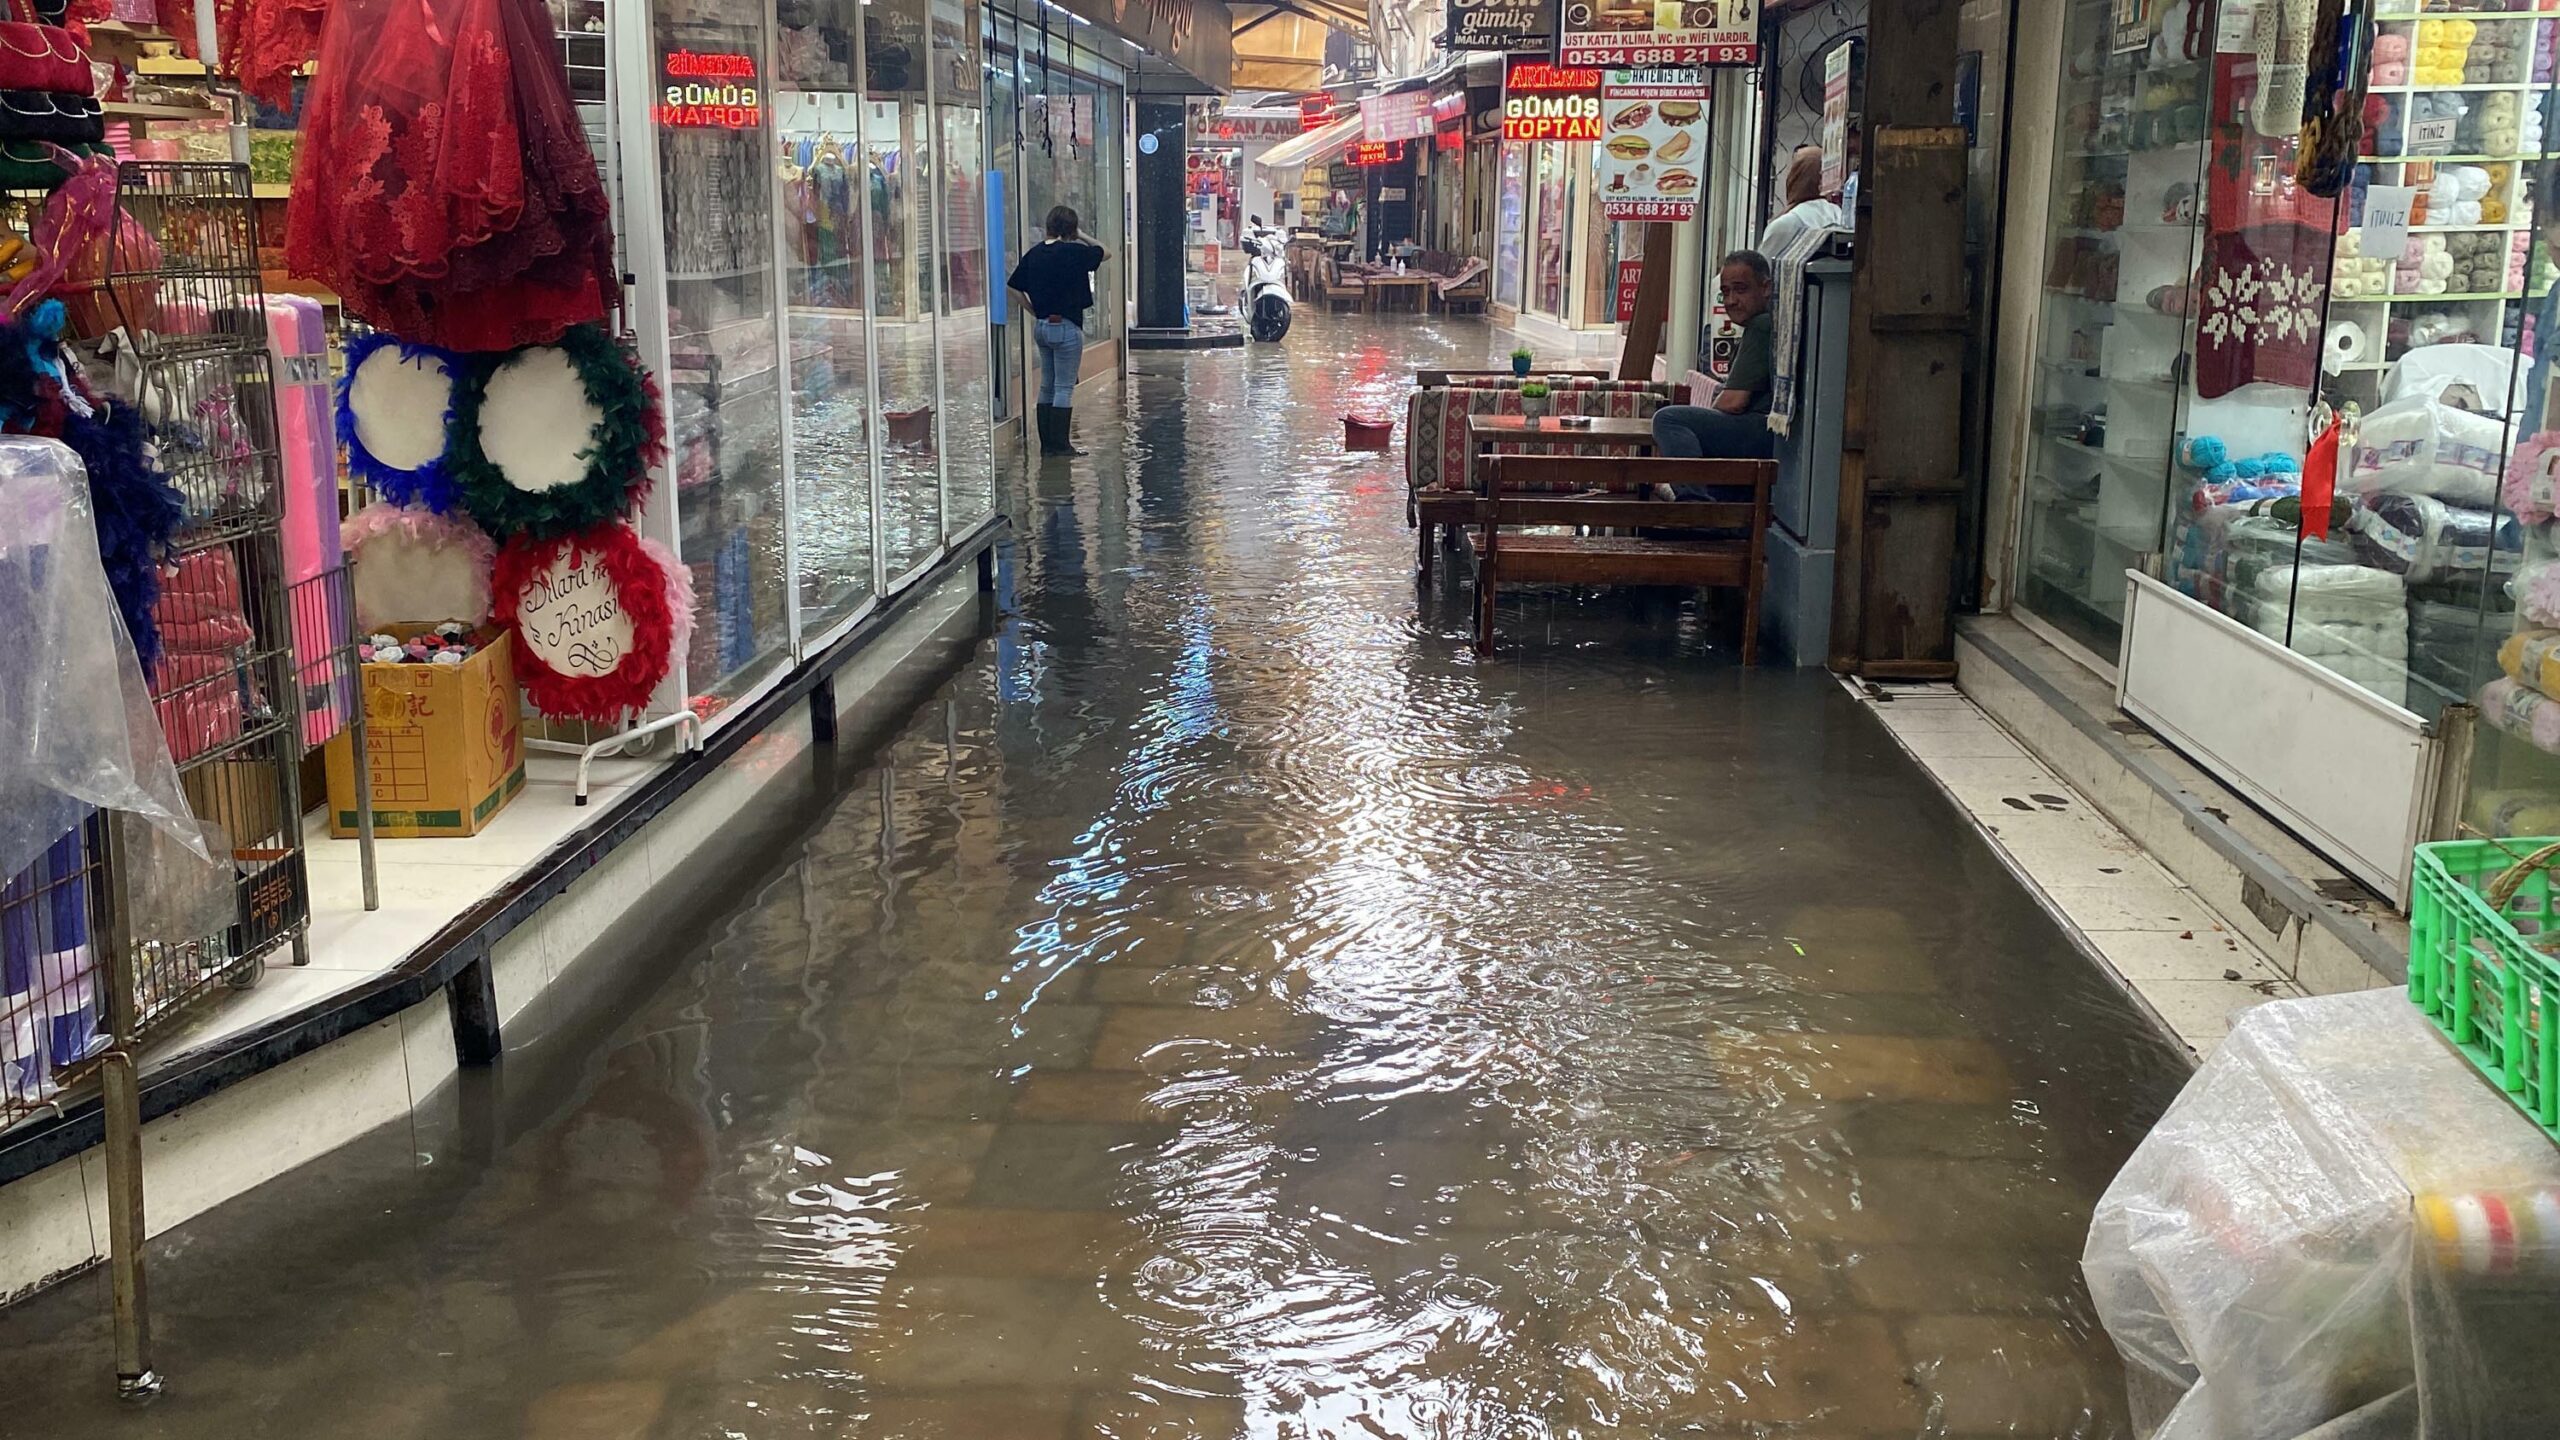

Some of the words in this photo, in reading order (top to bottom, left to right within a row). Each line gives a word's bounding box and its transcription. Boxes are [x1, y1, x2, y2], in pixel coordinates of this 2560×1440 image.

[1462, 8, 1534, 35] gümüş
[1492, 36, 1498, 45] &
[1565, 33, 1584, 46] ÜST
[1587, 33, 1618, 45] KATTA
[1621, 31, 1655, 46] KLİMA,
[1658, 33, 1673, 44] WC
[1676, 35, 1687, 44] ve
[1689, 31, 1710, 43] WİFİ
[1713, 32, 1752, 43] VARDIR.
[1567, 50, 1626, 65] 0534
[1633, 49, 1676, 63] 688
[1683, 49, 1709, 63] 21
[1719, 47, 1748, 62] 93
[1507, 95, 1600, 121] GÜMÜŞ
[1504, 118, 1602, 139] TOPTAN
[1605, 203, 1633, 215] 0534
[1637, 203, 1659, 215] 688
[1661, 204, 1676, 216] 21
[1680, 204, 1694, 216] 93
[1717, 363, 1729, 372] 05
[372, 756, 381, 766] A
[374, 772, 382, 782] B
[375, 789, 384, 798] C
